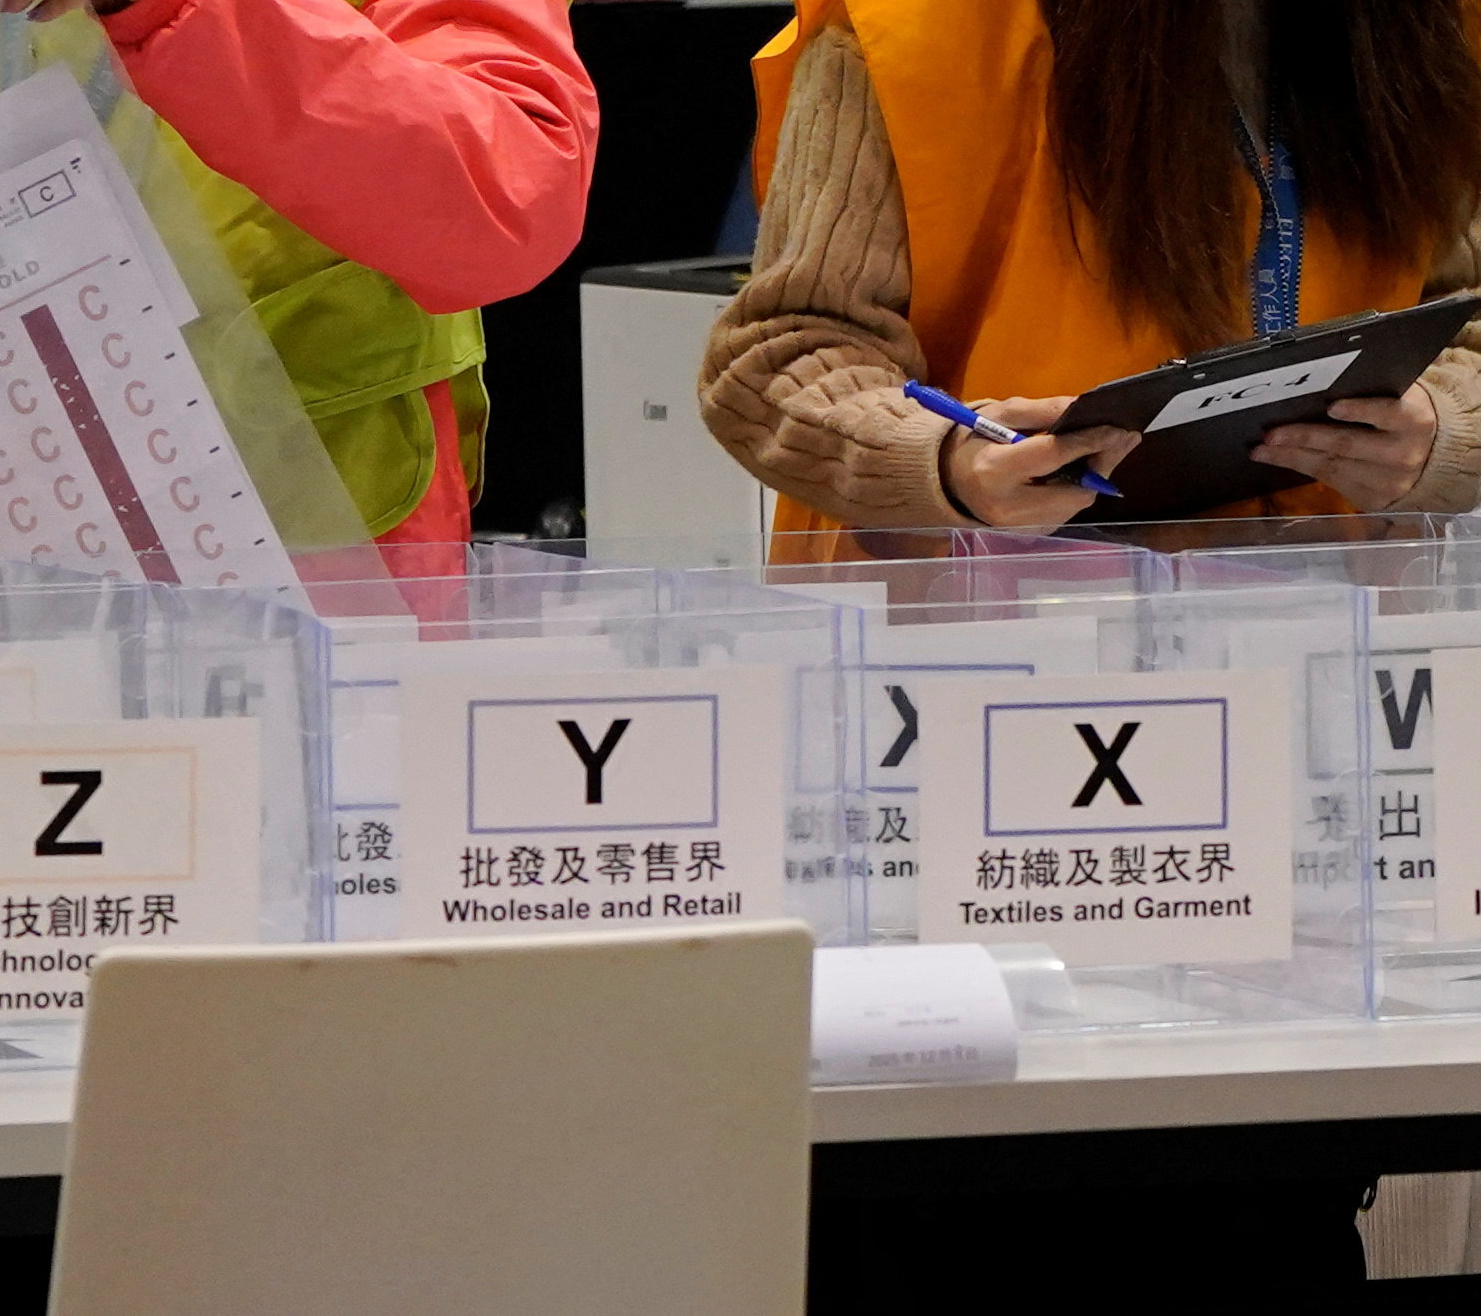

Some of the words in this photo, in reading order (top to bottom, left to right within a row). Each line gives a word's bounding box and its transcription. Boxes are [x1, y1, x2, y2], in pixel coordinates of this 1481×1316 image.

[39, 185, 55, 203] C
[1197, 381, 1272, 410] FC
[1283, 371, 1312, 391] 4
[556, 718, 633, 805] Y
[1070, 721, 1144, 809] X
[35, 770, 103, 856] Z
[459, 839, 727, 889] 批發及零售界
[974, 843, 1236, 891] 紡織及製衣界
[442, 895, 591, 923] Wholesale
[600, 895, 653, 921] and
[662, 892, 743, 919] Retail
[959, 895, 1064, 927] Textiles
[1075, 896, 1123, 922] and
[1131, 892, 1252, 922] Garment
